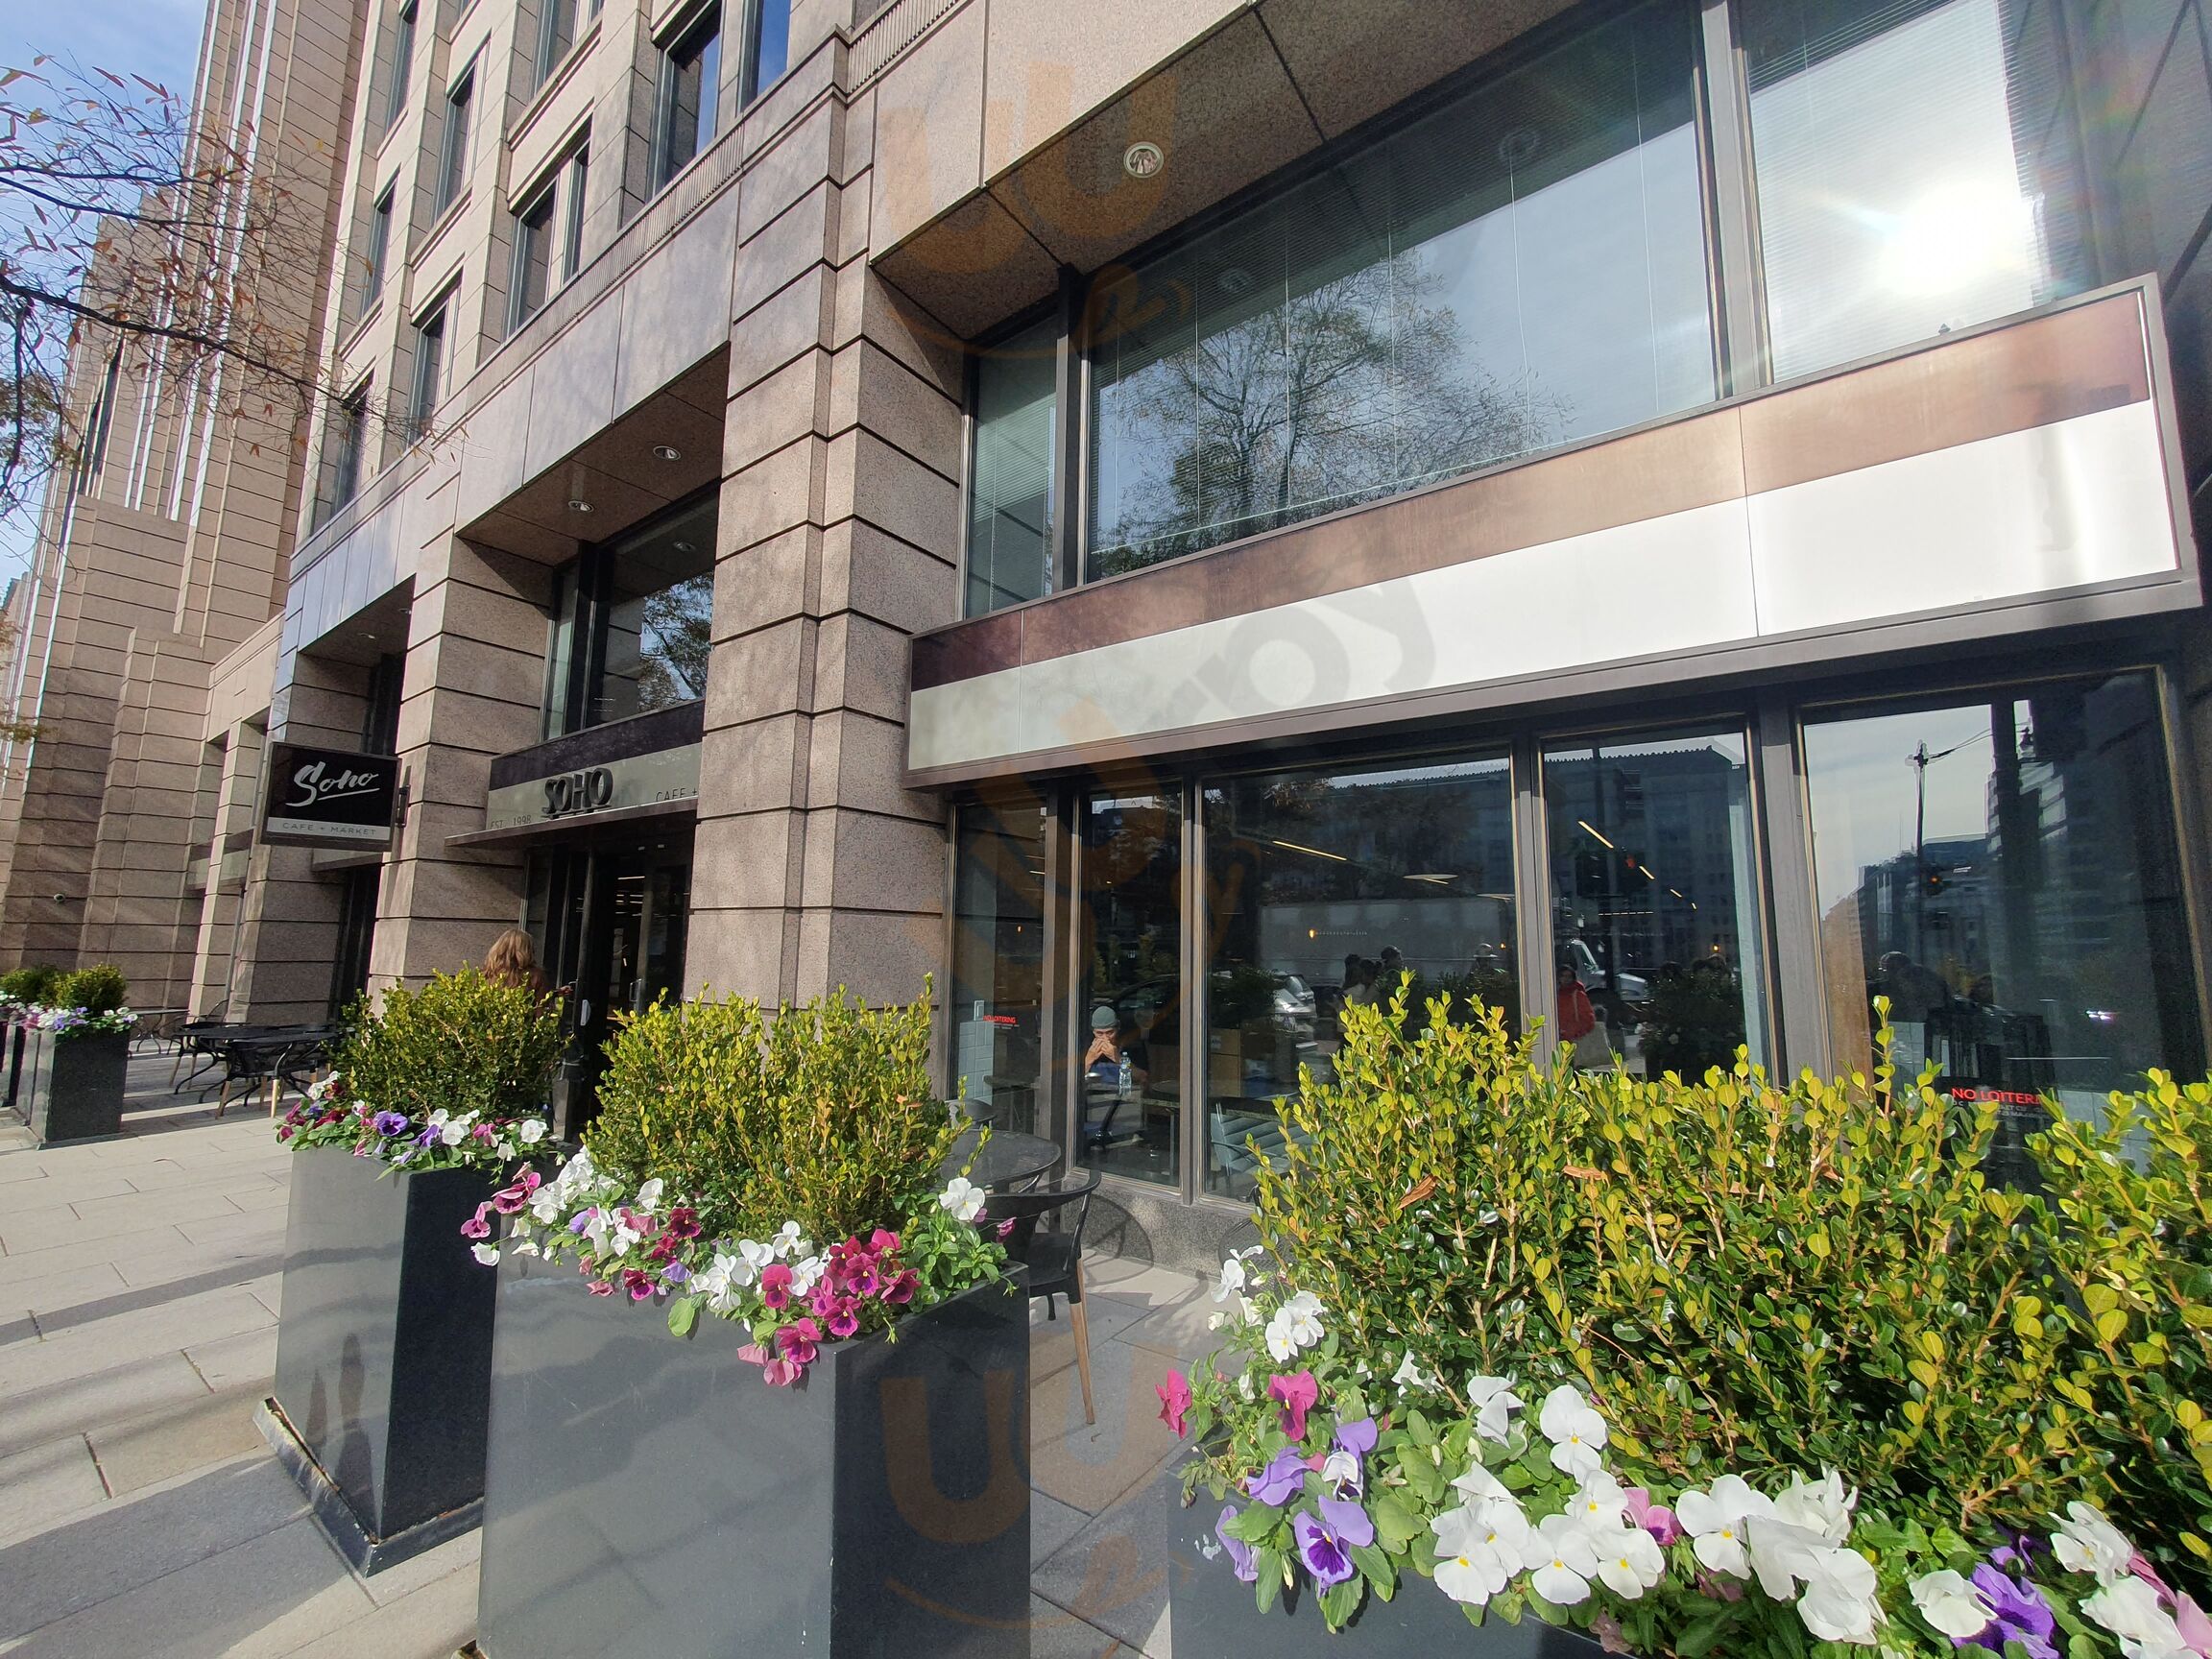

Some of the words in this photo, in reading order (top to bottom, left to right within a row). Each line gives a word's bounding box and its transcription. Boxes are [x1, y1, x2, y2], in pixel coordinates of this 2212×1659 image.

[285, 761, 380, 807] Soho
[541, 767, 613, 815] SOHO
[656, 787, 686, 802] CAFE
[282, 822, 314, 831] CAFE
[330, 826, 377, 835] MARKET
[1952, 1088, 1976, 1100] NO
